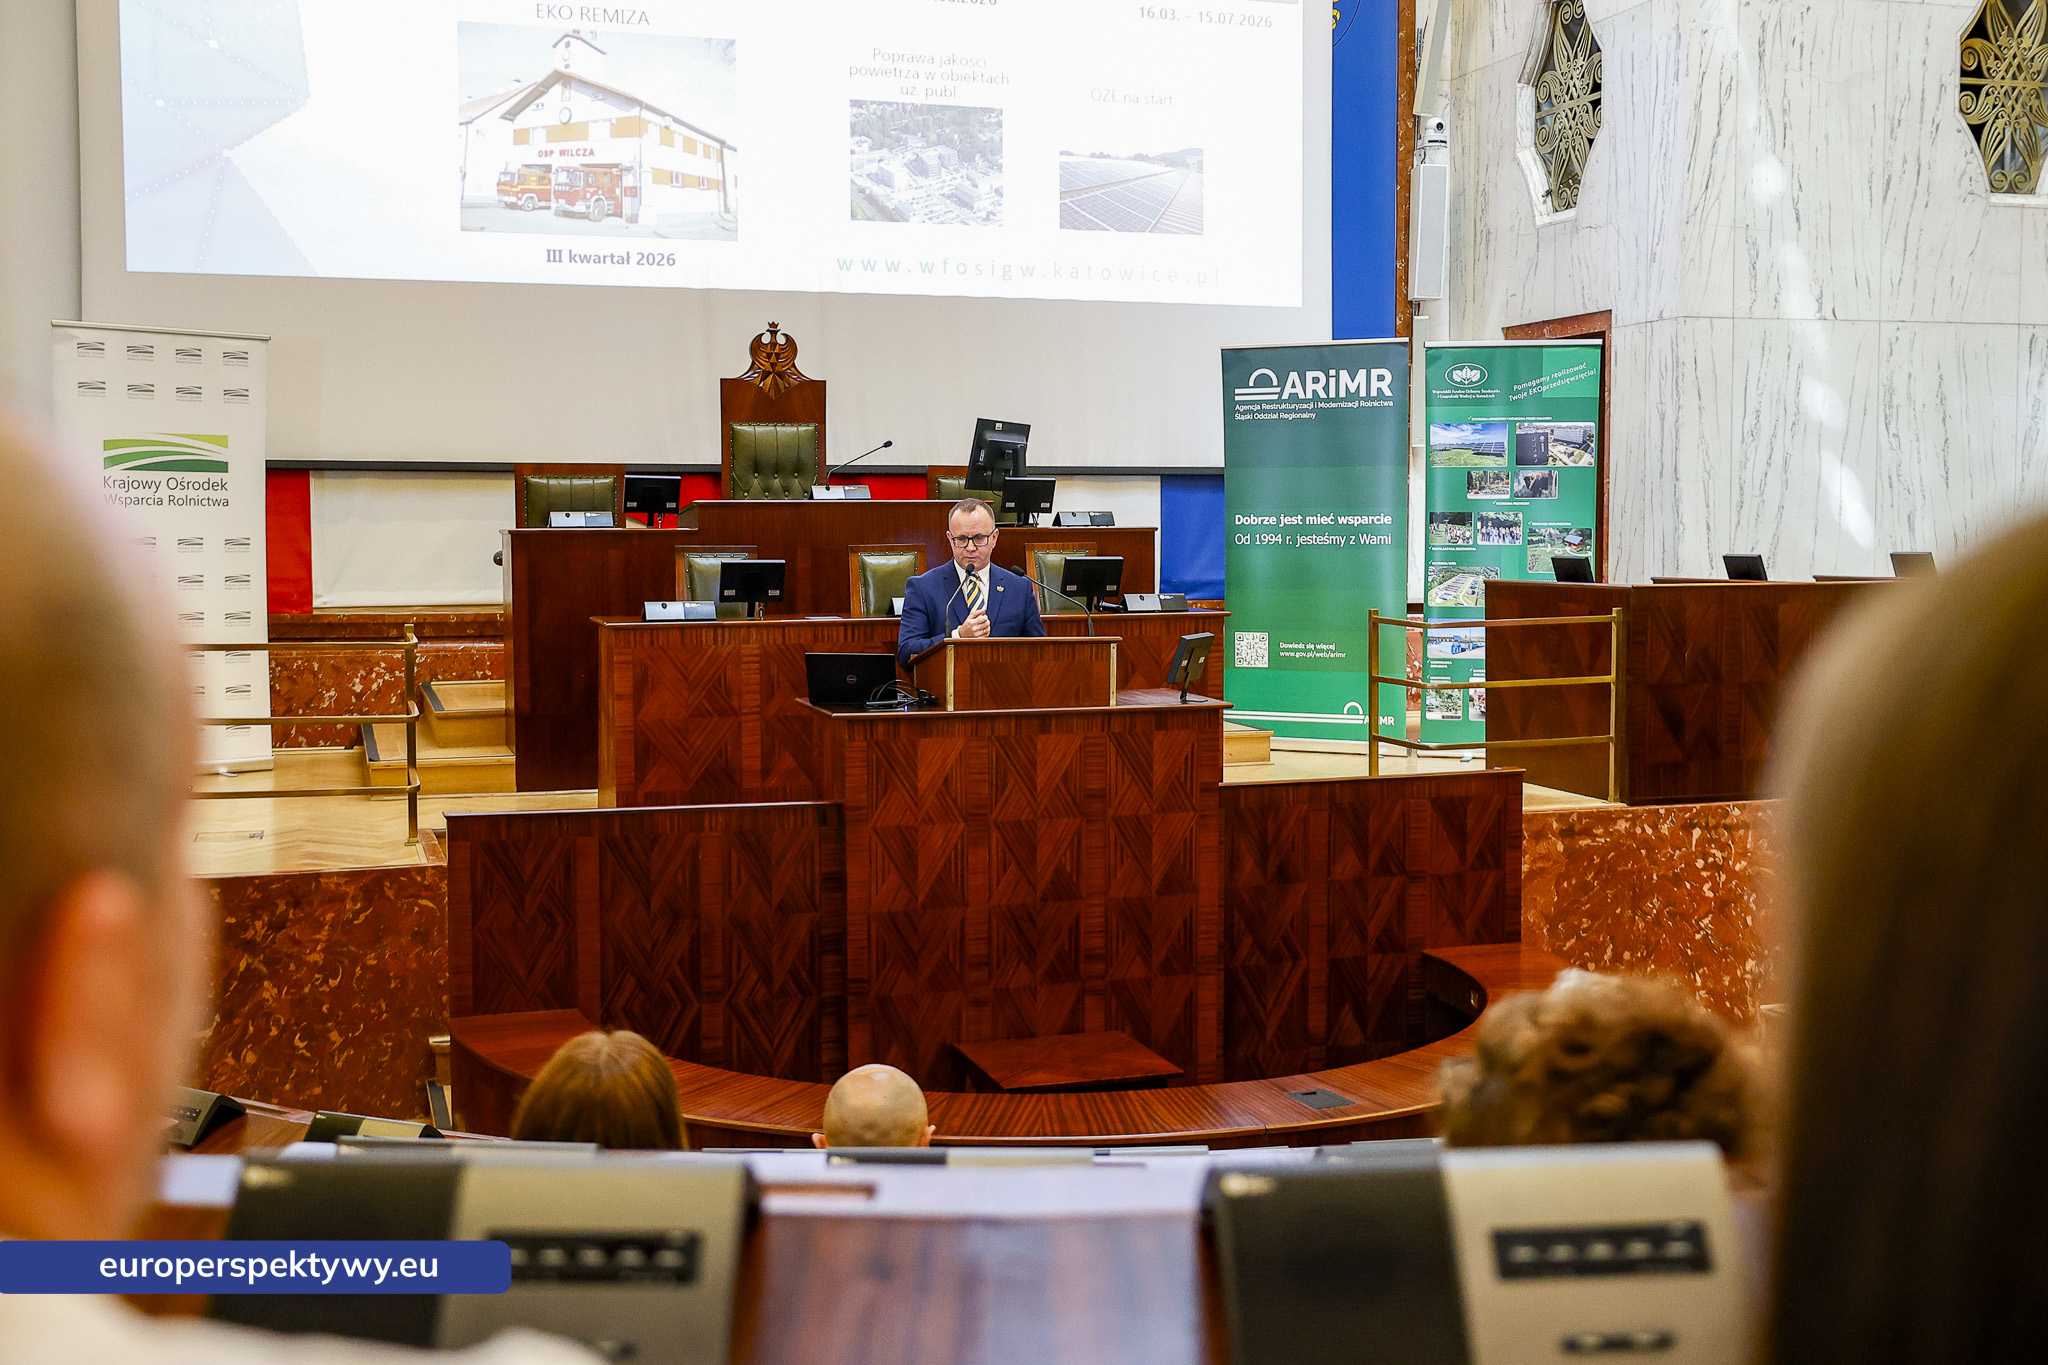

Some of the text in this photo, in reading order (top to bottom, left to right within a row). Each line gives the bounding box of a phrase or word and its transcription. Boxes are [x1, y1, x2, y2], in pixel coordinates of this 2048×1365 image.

[536, 4, 650, 26] EKO REMIZA
[1139, 6, 1180, 21] 16.03.
[1198, 11, 1272, 28] 15.07.2026
[873, 47, 934, 65] Poprawa
[850, 65, 1010, 85] powietrza w obiektach
[1090, 88, 1173, 106] OZE na start
[538, 148, 595, 158] OSP WILCZA
[546, 249, 676, 266] III kwartał 2026
[1281, 368, 1394, 400] ARiMR
[1513, 362, 1587, 392] Pomagamy realizować
[1508, 391, 1528, 402] Twoje
[1234, 404, 1260, 412] Agencja
[1262, 402, 1314, 411] Restrukturyzacji
[1318, 400, 1358, 408] Modernizacji
[1280, 412, 1316, 420] Regionalny
[103, 475, 228, 494] Krajowy Ośrodek
[104, 493, 229, 508] Wsparcia Rolnictwa
[1234, 512, 1392, 528] Dobrze jest mieć wsparcie
[1234, 532, 1392, 547] Od 1994 r. jesteśmy z Wami
[1306, 642, 1315, 650] się
[1316, 642, 1336, 650] więcej
[1364, 715, 1396, 726] AMR
